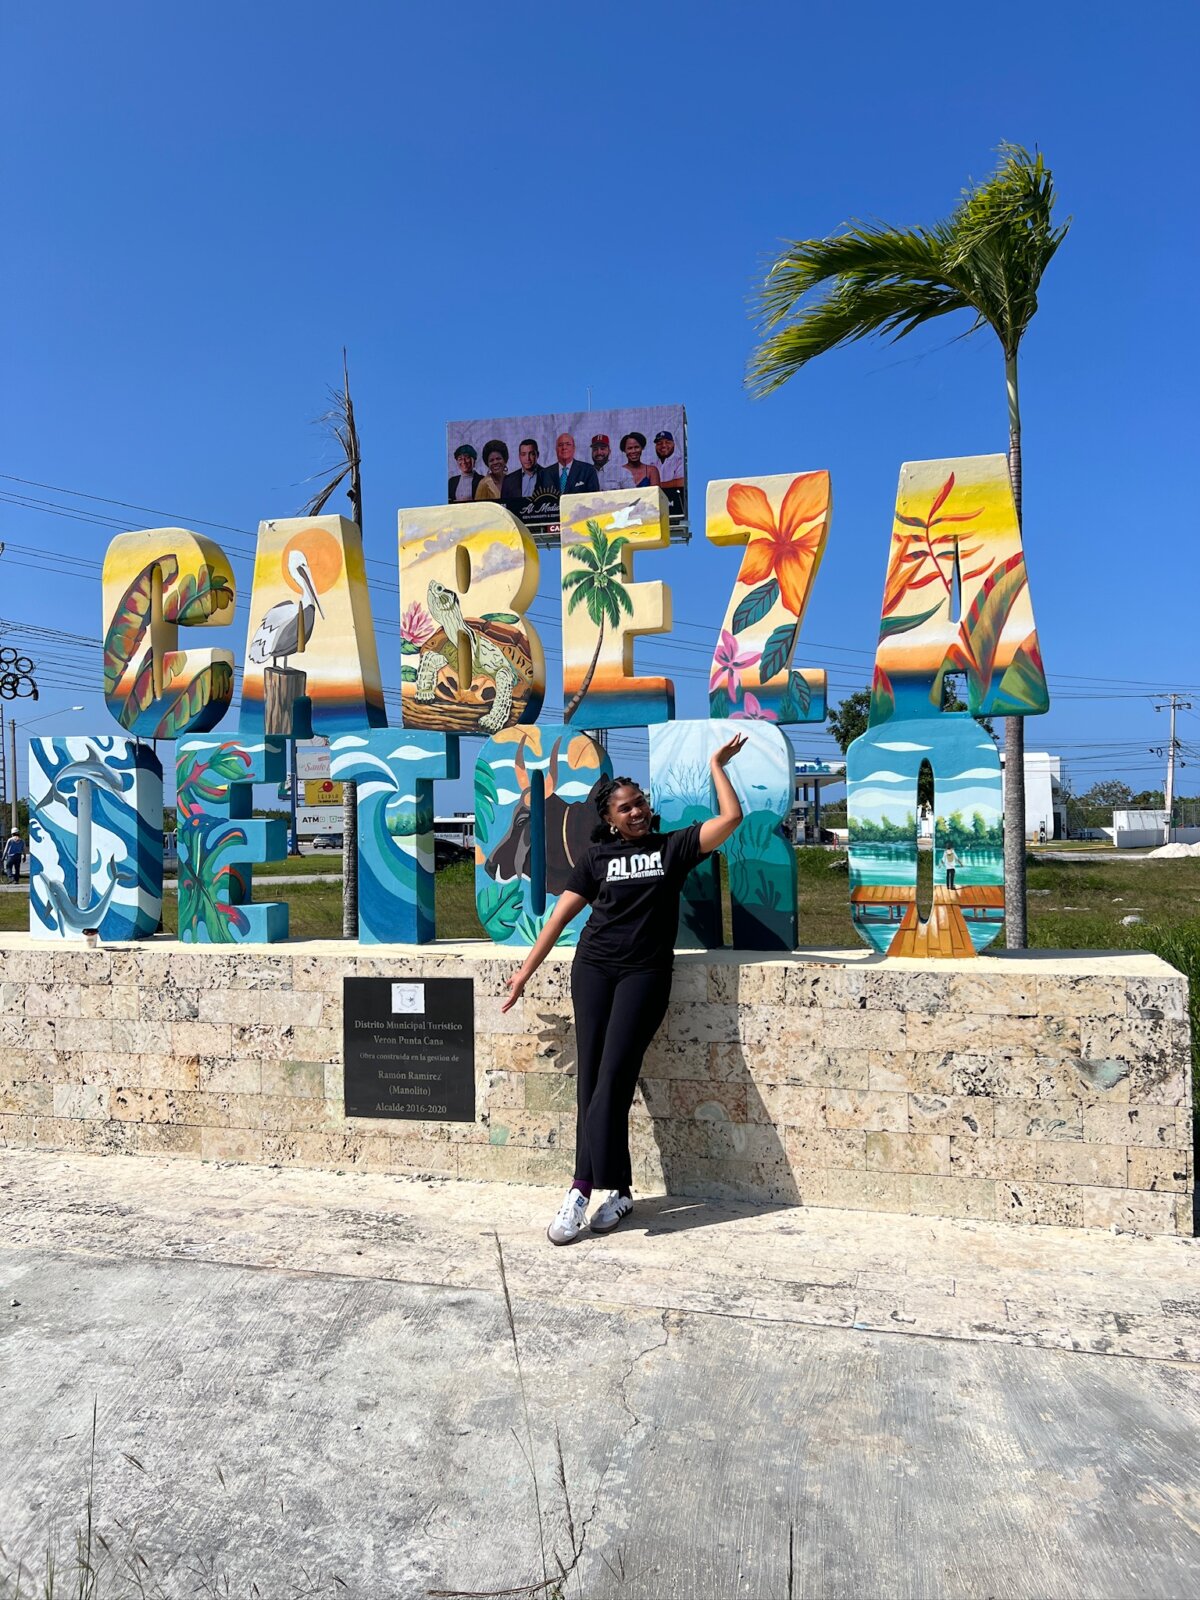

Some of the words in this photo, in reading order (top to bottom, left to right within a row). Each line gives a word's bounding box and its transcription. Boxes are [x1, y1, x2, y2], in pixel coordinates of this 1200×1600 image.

[102, 453, 1050, 740] CABEZA
[29, 734, 290, 944] DE
[328, 720, 1006, 959] TORO
[607, 851, 663, 876] ALMA
[354, 1020, 385, 1029] Distrito
[386, 1021, 426, 1031] Municipal
[398, 1036, 422, 1045] Punta
[423, 1036, 444, 1046] Cana
[378, 1070, 406, 1080] Ramón
[389, 1085, 431, 1097] (Manolito)
[375, 1102, 405, 1112] Alcalde
[406, 1104, 447, 1114] 2016-2020
